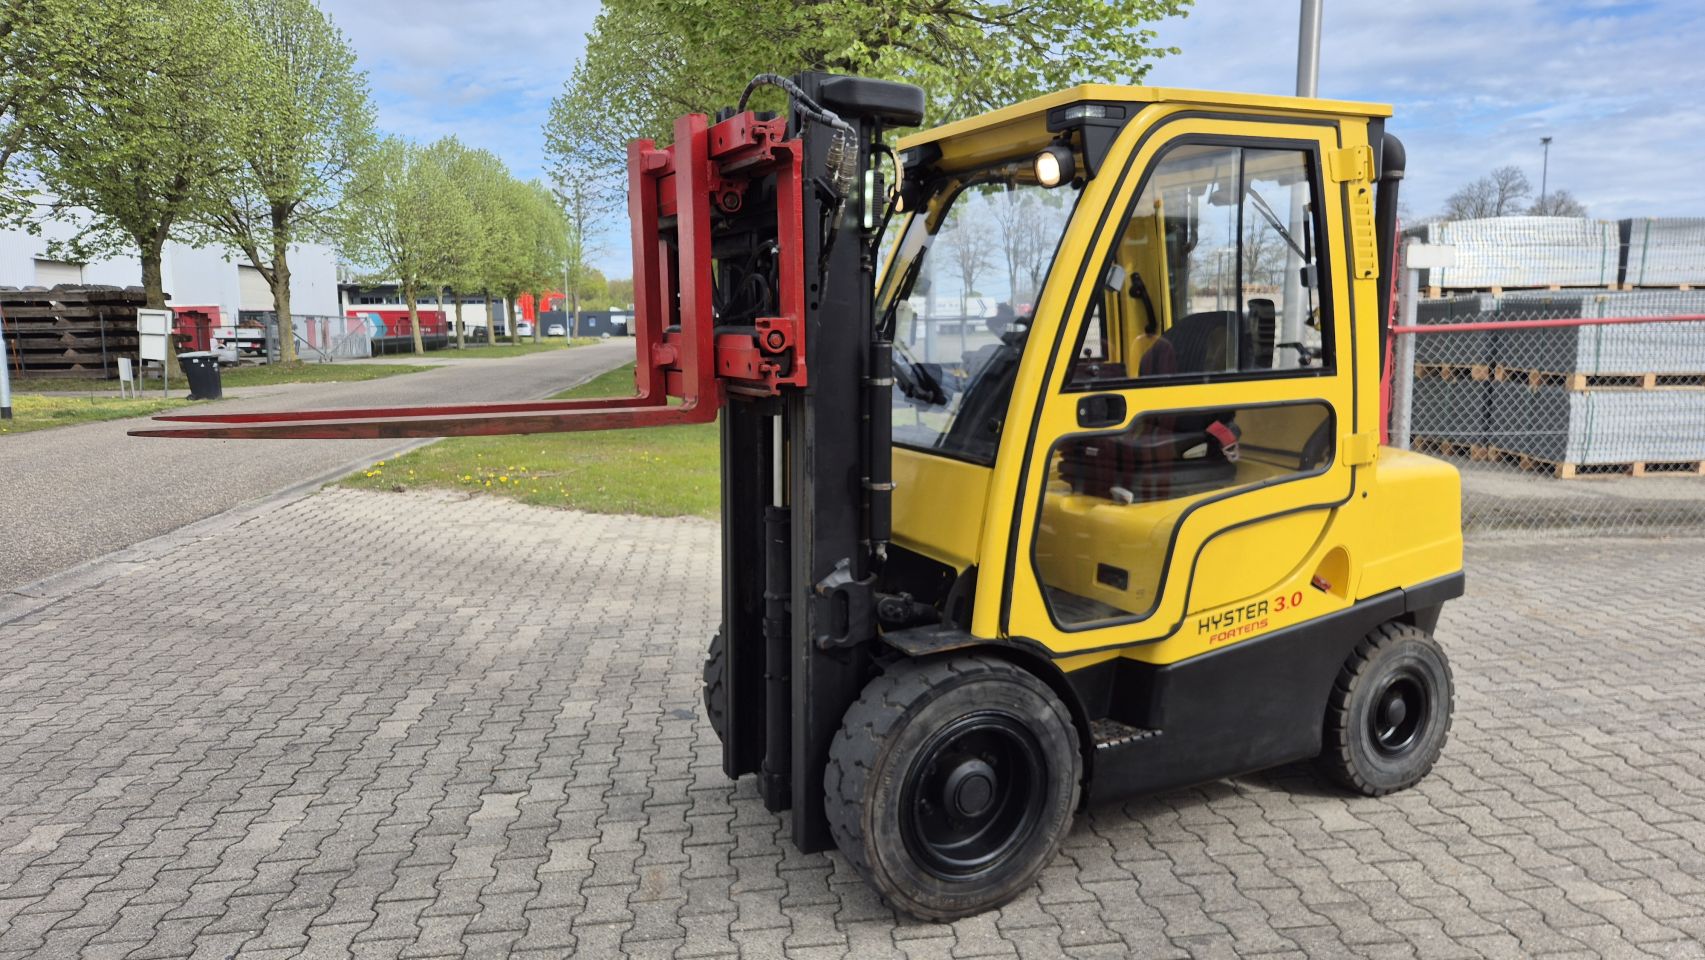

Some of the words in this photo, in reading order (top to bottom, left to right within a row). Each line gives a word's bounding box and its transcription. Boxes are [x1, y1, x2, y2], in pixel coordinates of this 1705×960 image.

[1198, 600, 1269, 635] HYSTER
[1273, 591, 1303, 613] 3.0
[1209, 618, 1269, 645] FORTENS
